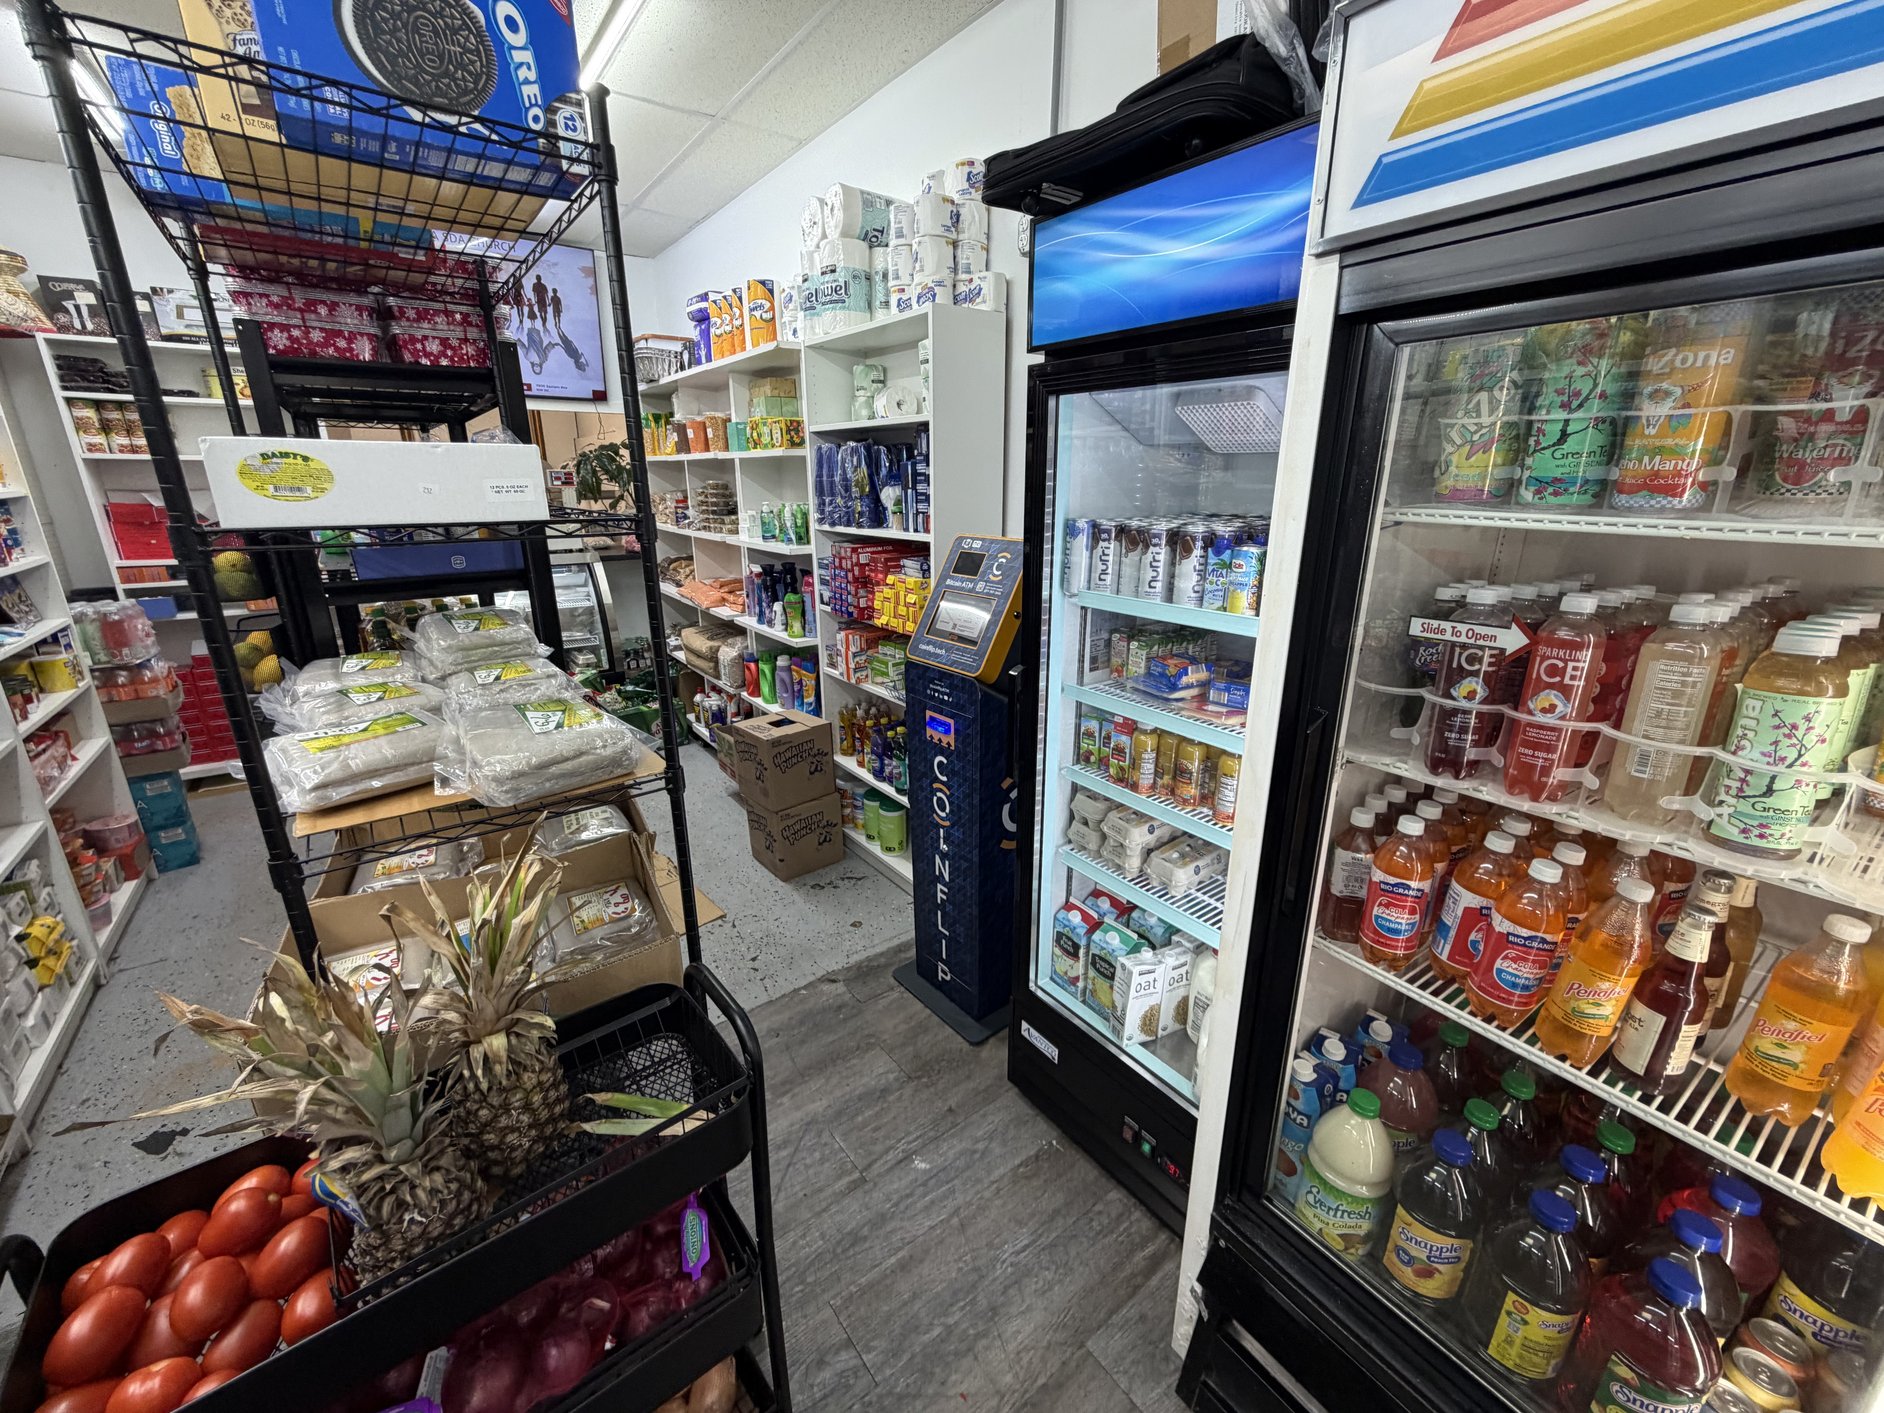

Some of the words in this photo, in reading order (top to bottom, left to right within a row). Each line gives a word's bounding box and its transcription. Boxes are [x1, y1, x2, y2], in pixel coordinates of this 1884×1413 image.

[417, 18, 441, 67] OREO
[494, 0, 545, 131] OREO
[220, 112, 232, 123] 42
[563, 113, 578, 134] 12
[1551, 447, 1598, 461] Green
[1207, 567, 1225, 579] VITA
[945, 578, 963, 587] Bitcoin
[962, 580, 975, 590] ATM
[1419, 621, 1447, 637] Slide
[1450, 625, 1463, 639] To
[1465, 627, 1498, 644] Open
[1451, 648, 1501, 672] ICE
[1531, 656, 1587, 686] ICE
[1655, 679, 1682, 689] Calories
[1444, 731, 1460, 740] ZERO
[772, 739, 815, 768] HAWAIIAN
[779, 751, 812, 774] PUNCH
[1518, 747, 1534, 756] ZERO
[1534, 750, 1558, 760] SUGAR
[1751, 800, 1799, 817] Green
[781, 810, 824, 841] HAWAIIAN
[788, 822, 820, 846] PUNCH
[931, 755, 952, 983] COINFLIP
[1380, 883, 1393, 892] RIO
[1393, 886, 1423, 898] GRANDE
[1508, 935, 1526, 945] RIO
[1516, 961, 1540, 971] COLA
[1134, 976, 1159, 994] oat
[1167, 969, 1191, 988] oat
[1305, 1184, 1372, 1222] Everfresh
[689, 1216, 698, 1256] ONIONS
[1332, 1221, 1363, 1230] Colada
[1398, 1225, 1463, 1257] Snapple
[1779, 1295, 1868, 1342] Snapple
